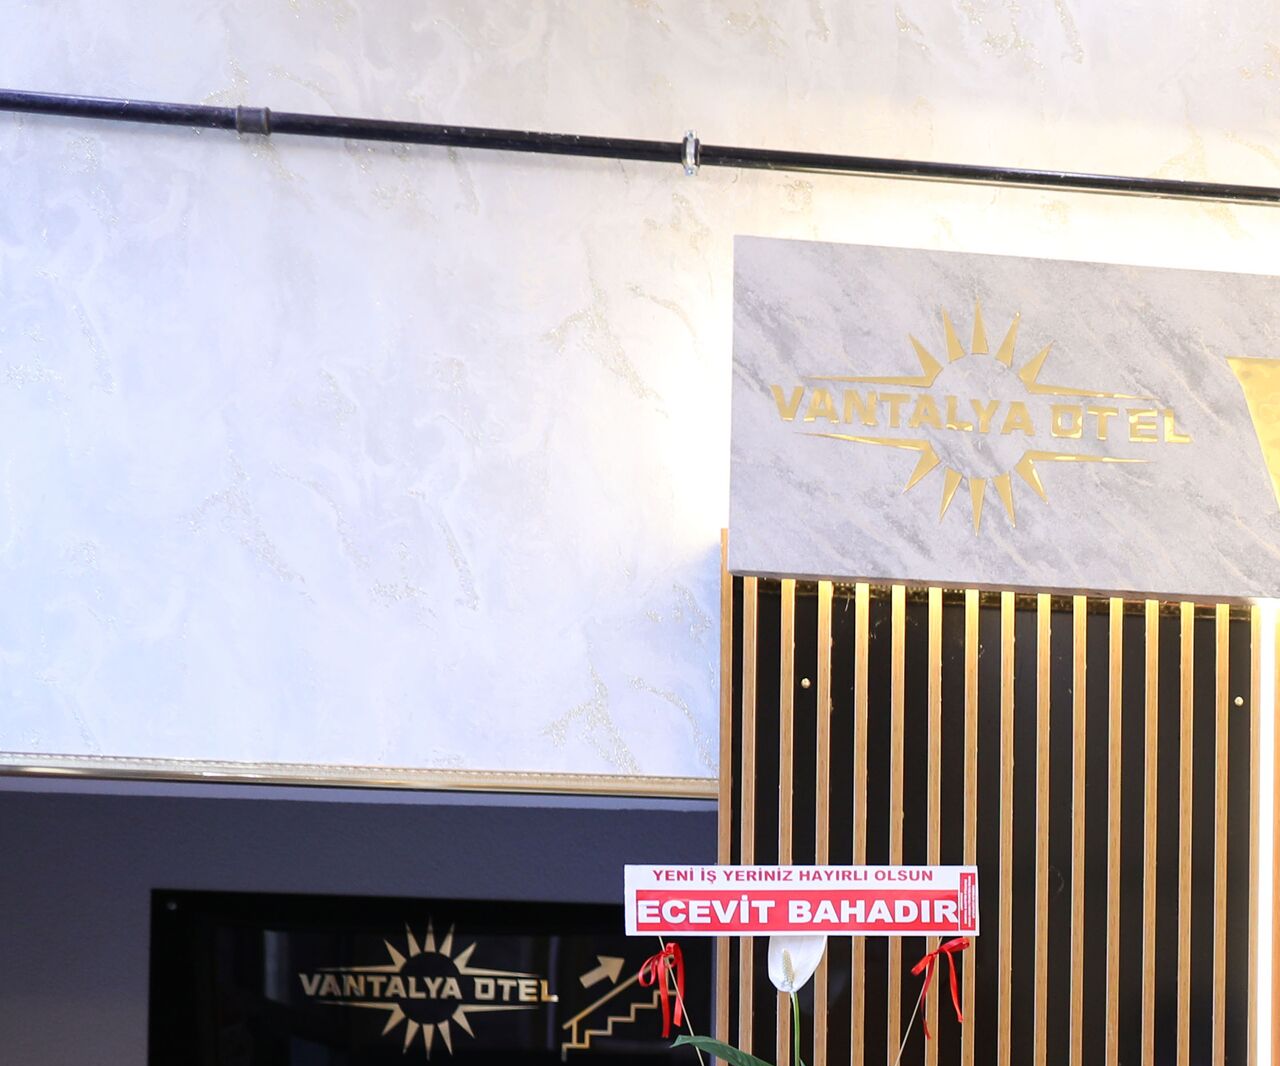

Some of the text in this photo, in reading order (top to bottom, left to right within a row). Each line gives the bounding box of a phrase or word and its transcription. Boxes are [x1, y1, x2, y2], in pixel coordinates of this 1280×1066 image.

[770, 384, 1195, 443] VANTALYA OTEL
[652, 867, 934, 883] YENİ İŞ YERİNİZ HAYIRLI OLSUN
[637, 895, 775, 924] ECEVİT
[788, 899, 958, 924] BAHADIR
[299, 973, 559, 1002] VANTALYA OTEL
